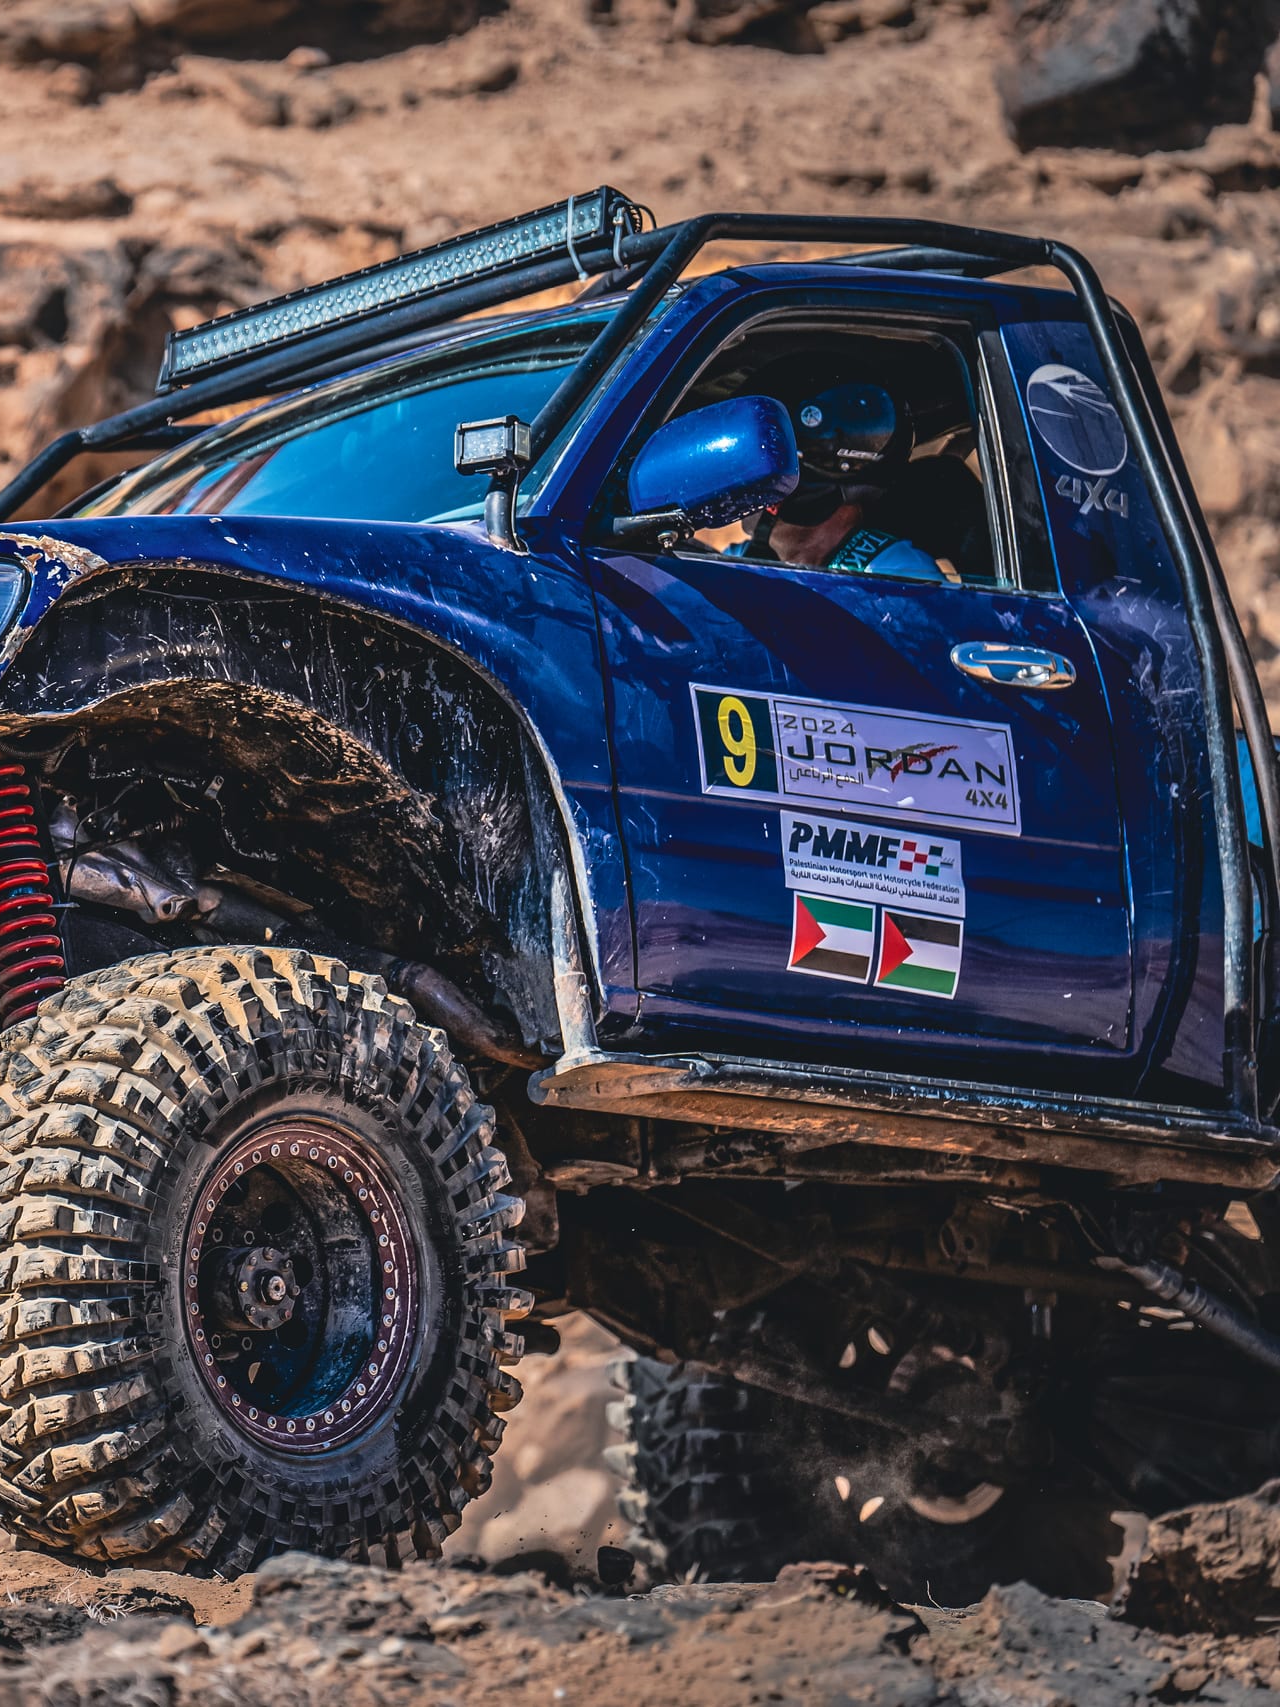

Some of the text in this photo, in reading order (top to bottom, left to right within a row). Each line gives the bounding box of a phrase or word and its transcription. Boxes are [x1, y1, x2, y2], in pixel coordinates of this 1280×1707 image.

[717, 696, 757, 787] 9
[783, 714, 857, 737] 2024
[787, 734, 1007, 786] JORDAN
[965, 789, 1009, 810] 4X4
[789, 821, 901, 868] PMMF
[789, 858, 960, 894] Palestinian Motorsport and Motorcycle Federation
